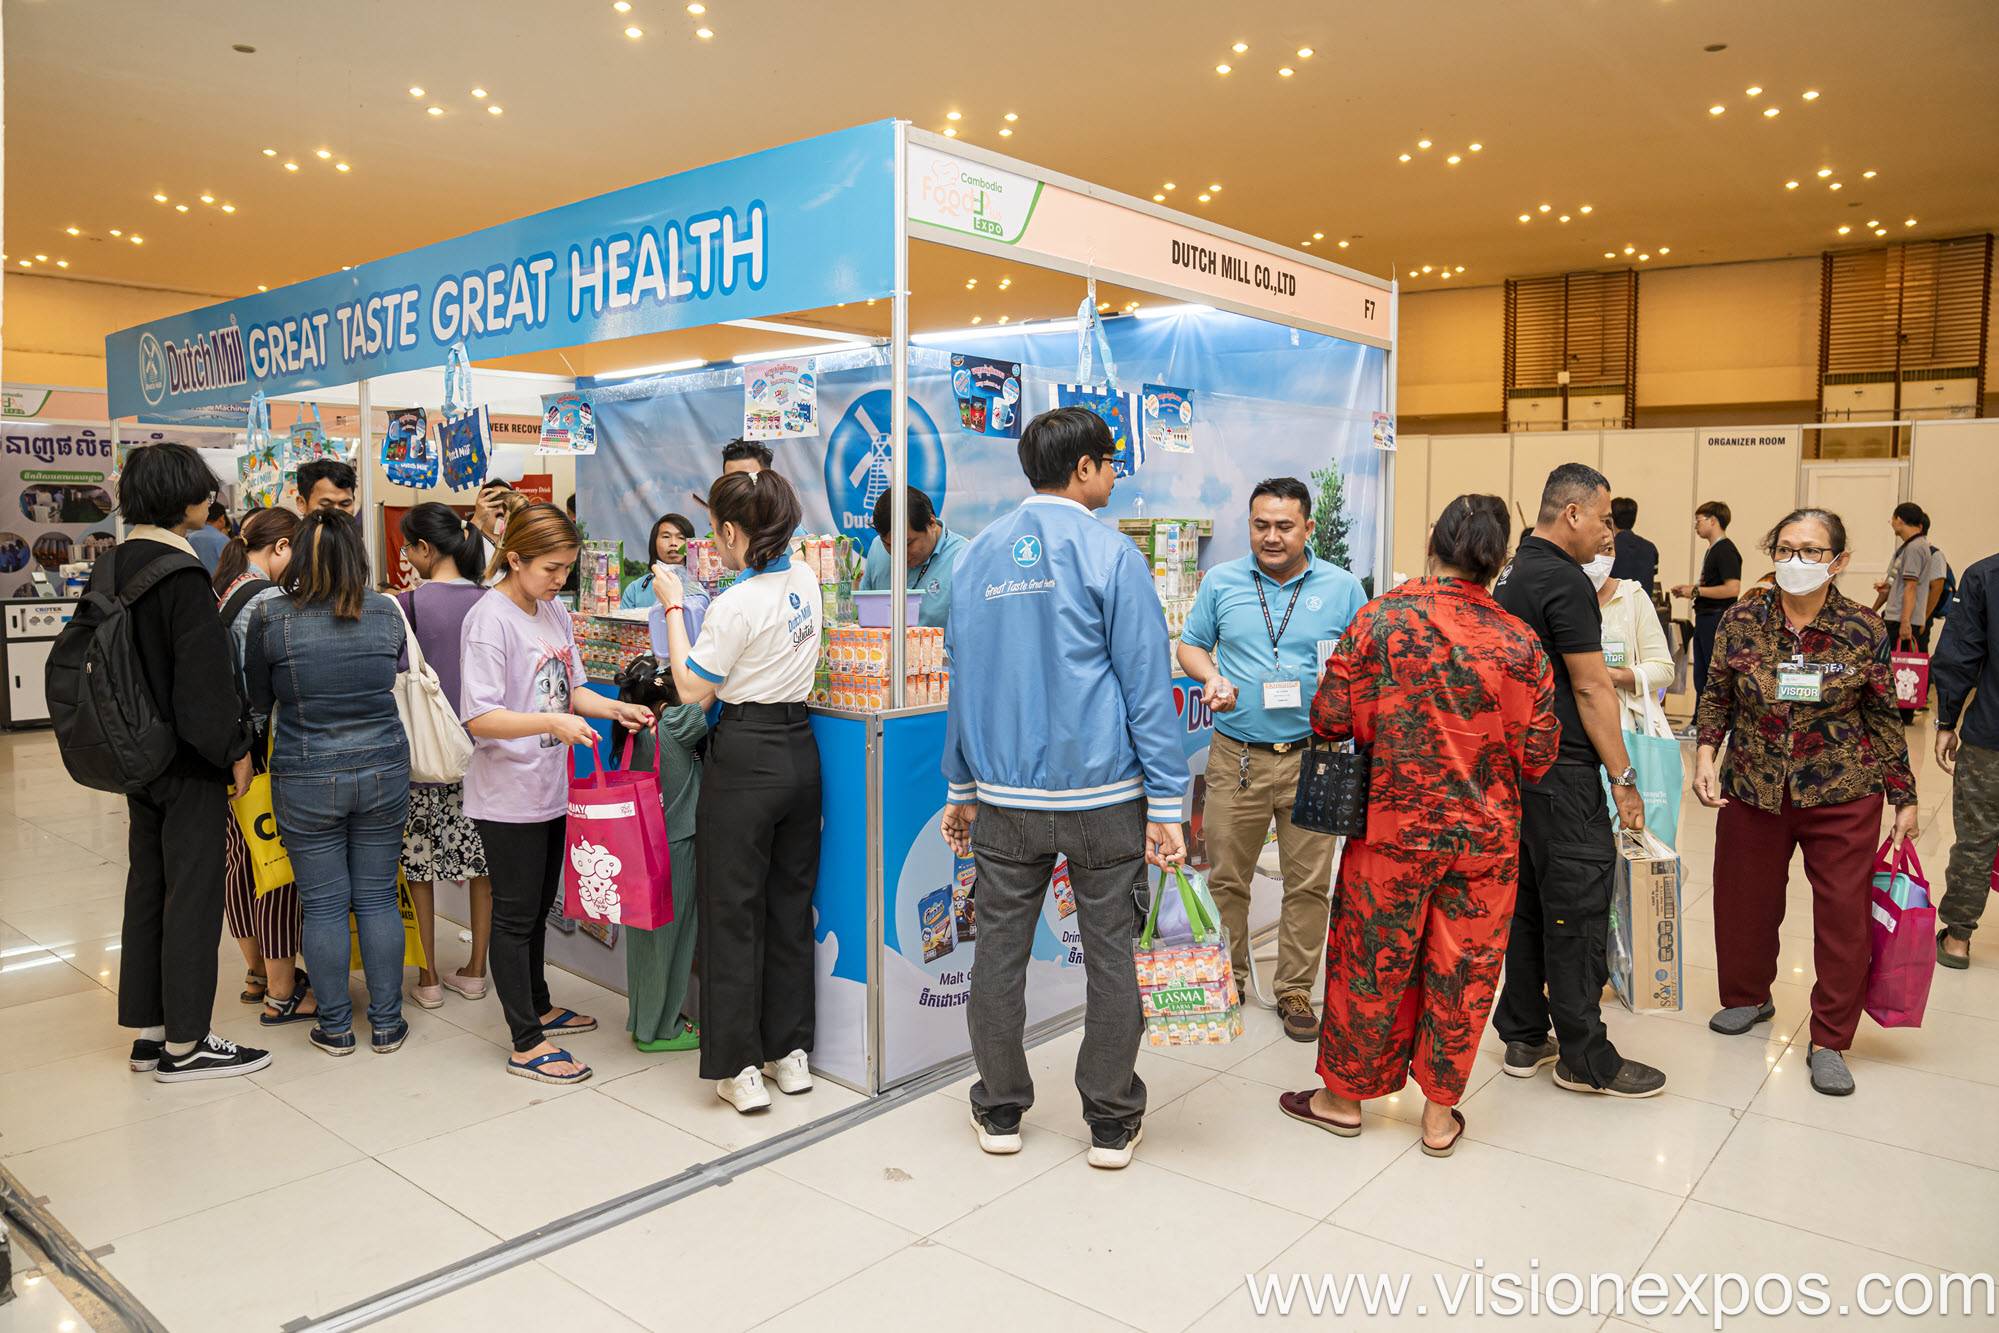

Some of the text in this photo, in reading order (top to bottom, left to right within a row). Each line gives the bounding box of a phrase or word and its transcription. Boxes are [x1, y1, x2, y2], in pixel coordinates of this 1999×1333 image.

[960, 172, 1003, 194] Cambodia
[974, 218, 1003, 236] Expo
[1171, 239, 1296, 297] DUTCH MILL CO.,LTD
[164, 206, 764, 396] Dutch Mill GREAT TASTE GREAT HEALTH
[1364, 299, 1376, 321] F7
[511, 423, 542, 434] RECOVE
[1708, 436, 1786, 446] ORGANIZER ROOM
[843, 511, 874, 529] Dut
[1007, 578, 1028, 593] Taste
[1780, 686, 1818, 698] VISITOR
[1062, 930, 1081, 943] Drin
[939, 971, 964, 986] Malt
[1155, 989, 1202, 1004] TASMA
